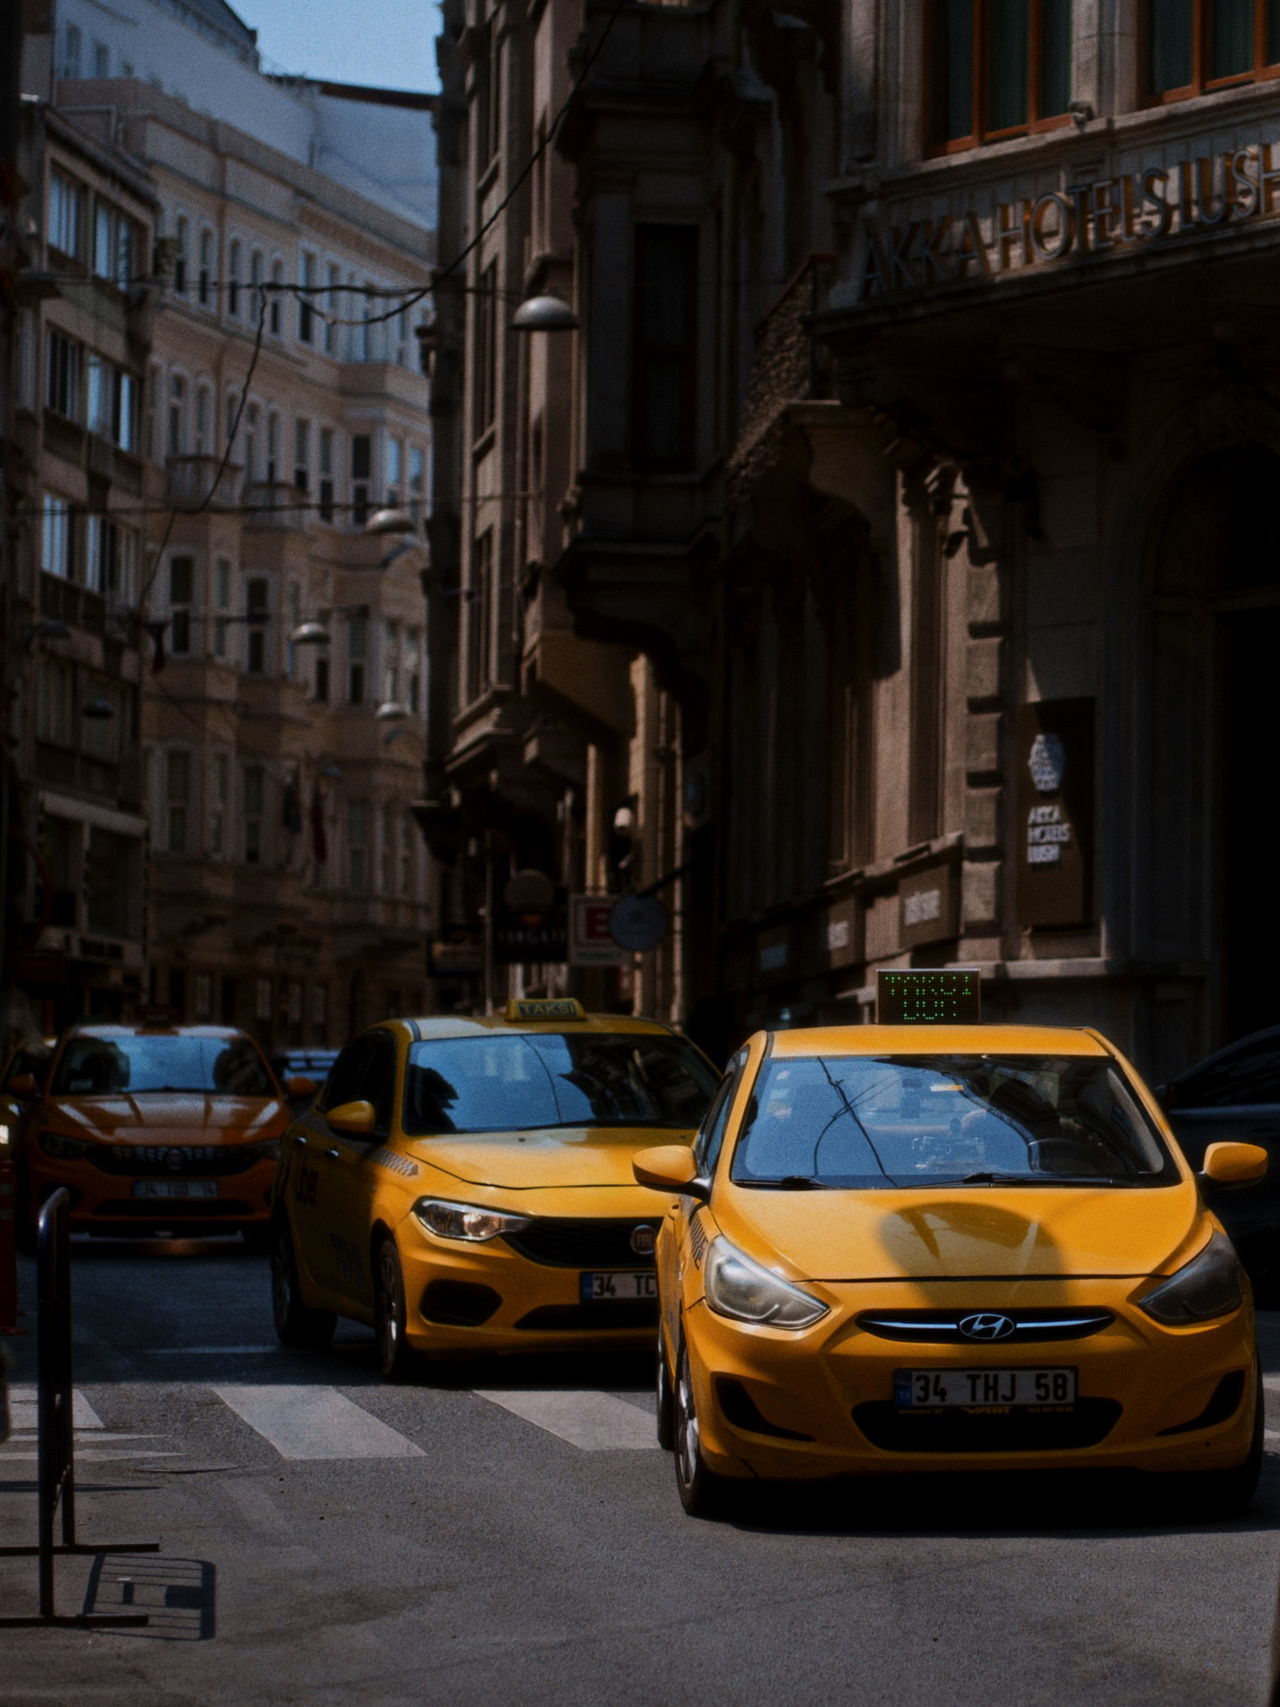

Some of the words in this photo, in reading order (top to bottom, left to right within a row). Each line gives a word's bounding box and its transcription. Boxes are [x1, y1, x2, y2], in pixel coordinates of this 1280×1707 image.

[861, 211, 991, 301] AKKA
[997, 168, 1169, 270] HOTELS
[594, 1275, 616, 1297] 34
[915, 1374, 947, 1402] 34
[966, 1373, 1016, 1402] THJ
[1035, 1373, 1068, 1402] 58
